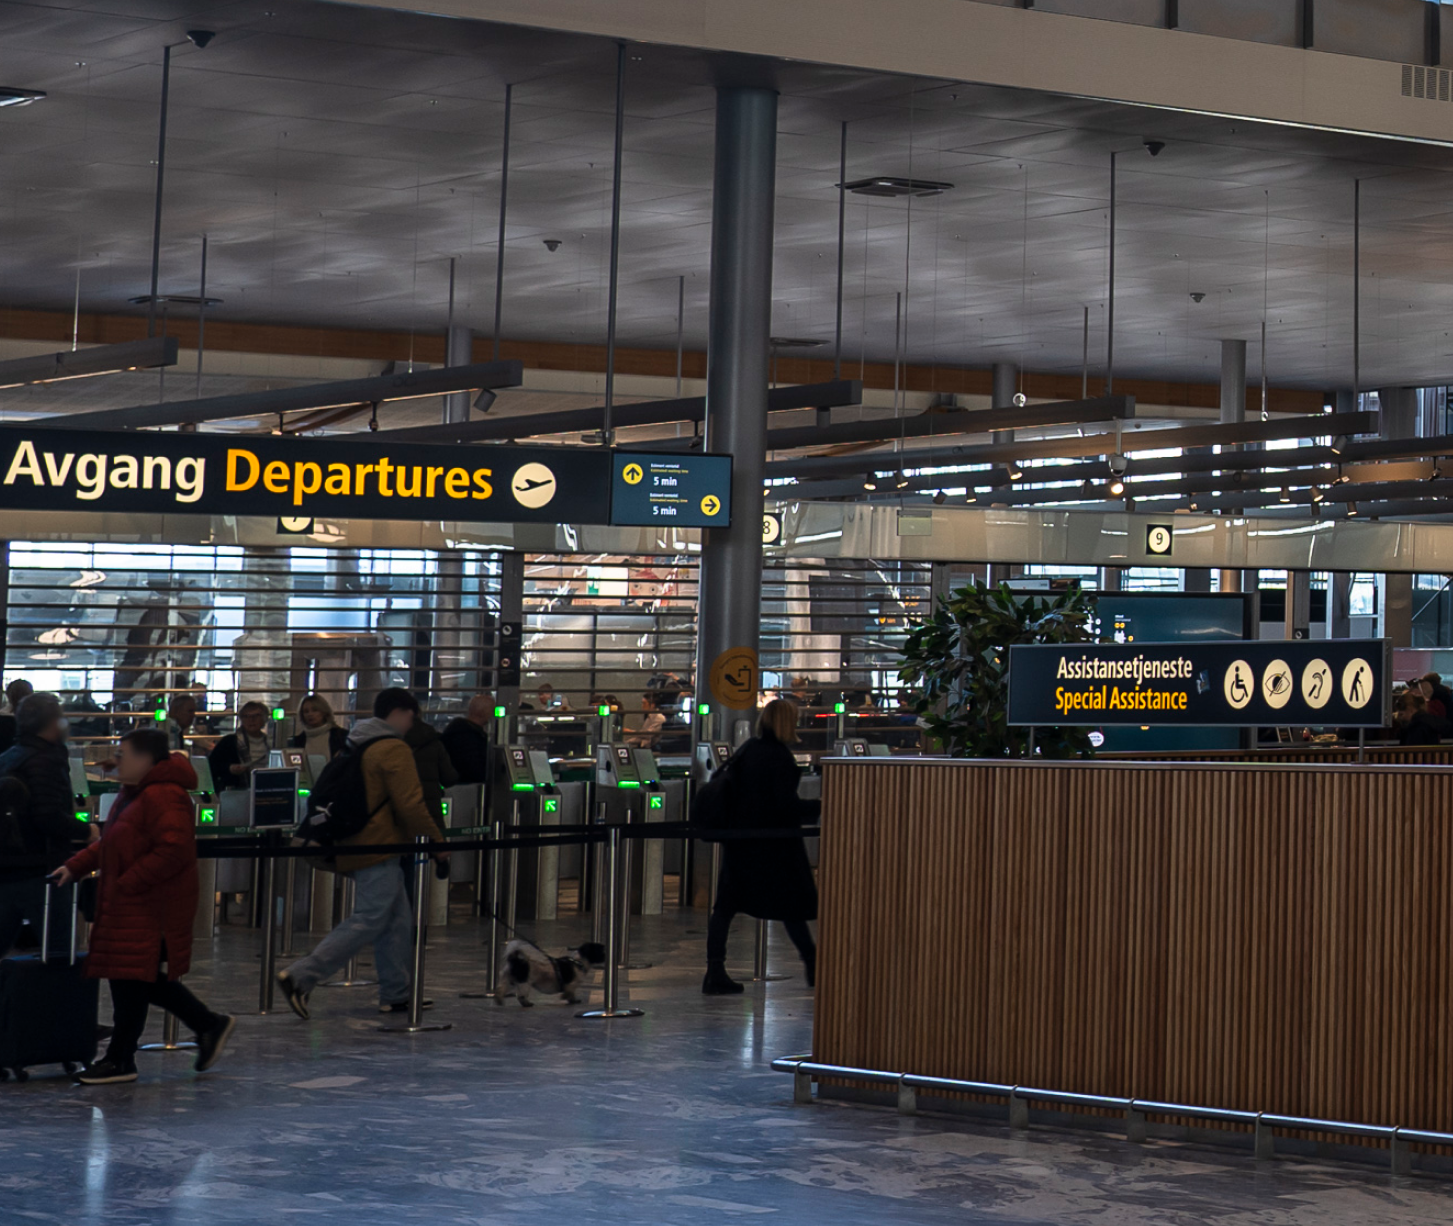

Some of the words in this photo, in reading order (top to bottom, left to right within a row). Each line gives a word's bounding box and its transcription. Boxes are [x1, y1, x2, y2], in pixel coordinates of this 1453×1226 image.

[3, 440, 206, 503] Avgang
[225, 448, 493, 506] Departures
[653, 476, 659, 486] 5
[661, 476, 677, 486] min
[653, 506, 659, 515] 5
[660, 506, 677, 515] min
[763, 521, 771, 534] 8
[1156, 532, 1164, 546] 9
[1057, 654, 1193, 685] Assistansetjeneste
[1056, 685, 1107, 715] Special
[1109, 685, 1188, 710] Assistance
